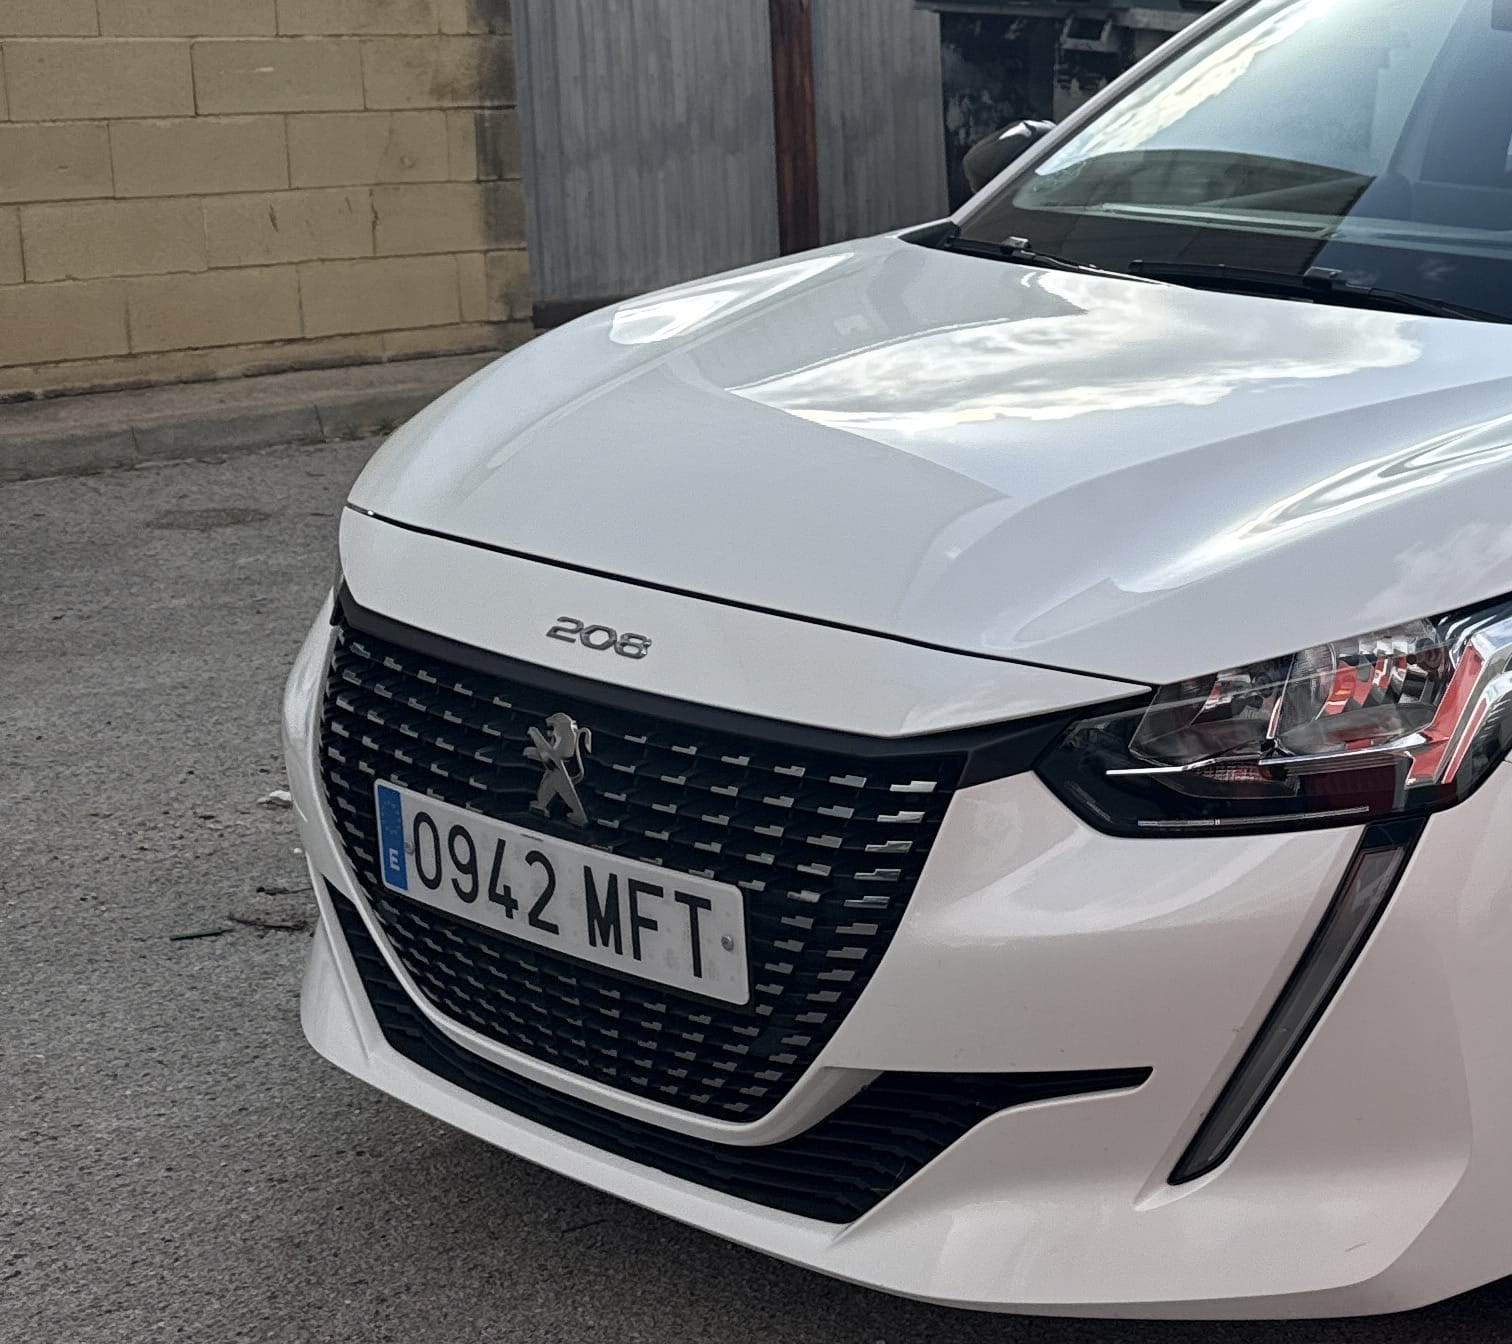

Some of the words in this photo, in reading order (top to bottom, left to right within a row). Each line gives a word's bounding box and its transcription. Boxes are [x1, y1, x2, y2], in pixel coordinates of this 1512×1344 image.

[547, 616, 652, 659] 208
[388, 847, 401, 871] E
[413, 811, 560, 936] 0942
[583, 864, 712, 979] MFT
